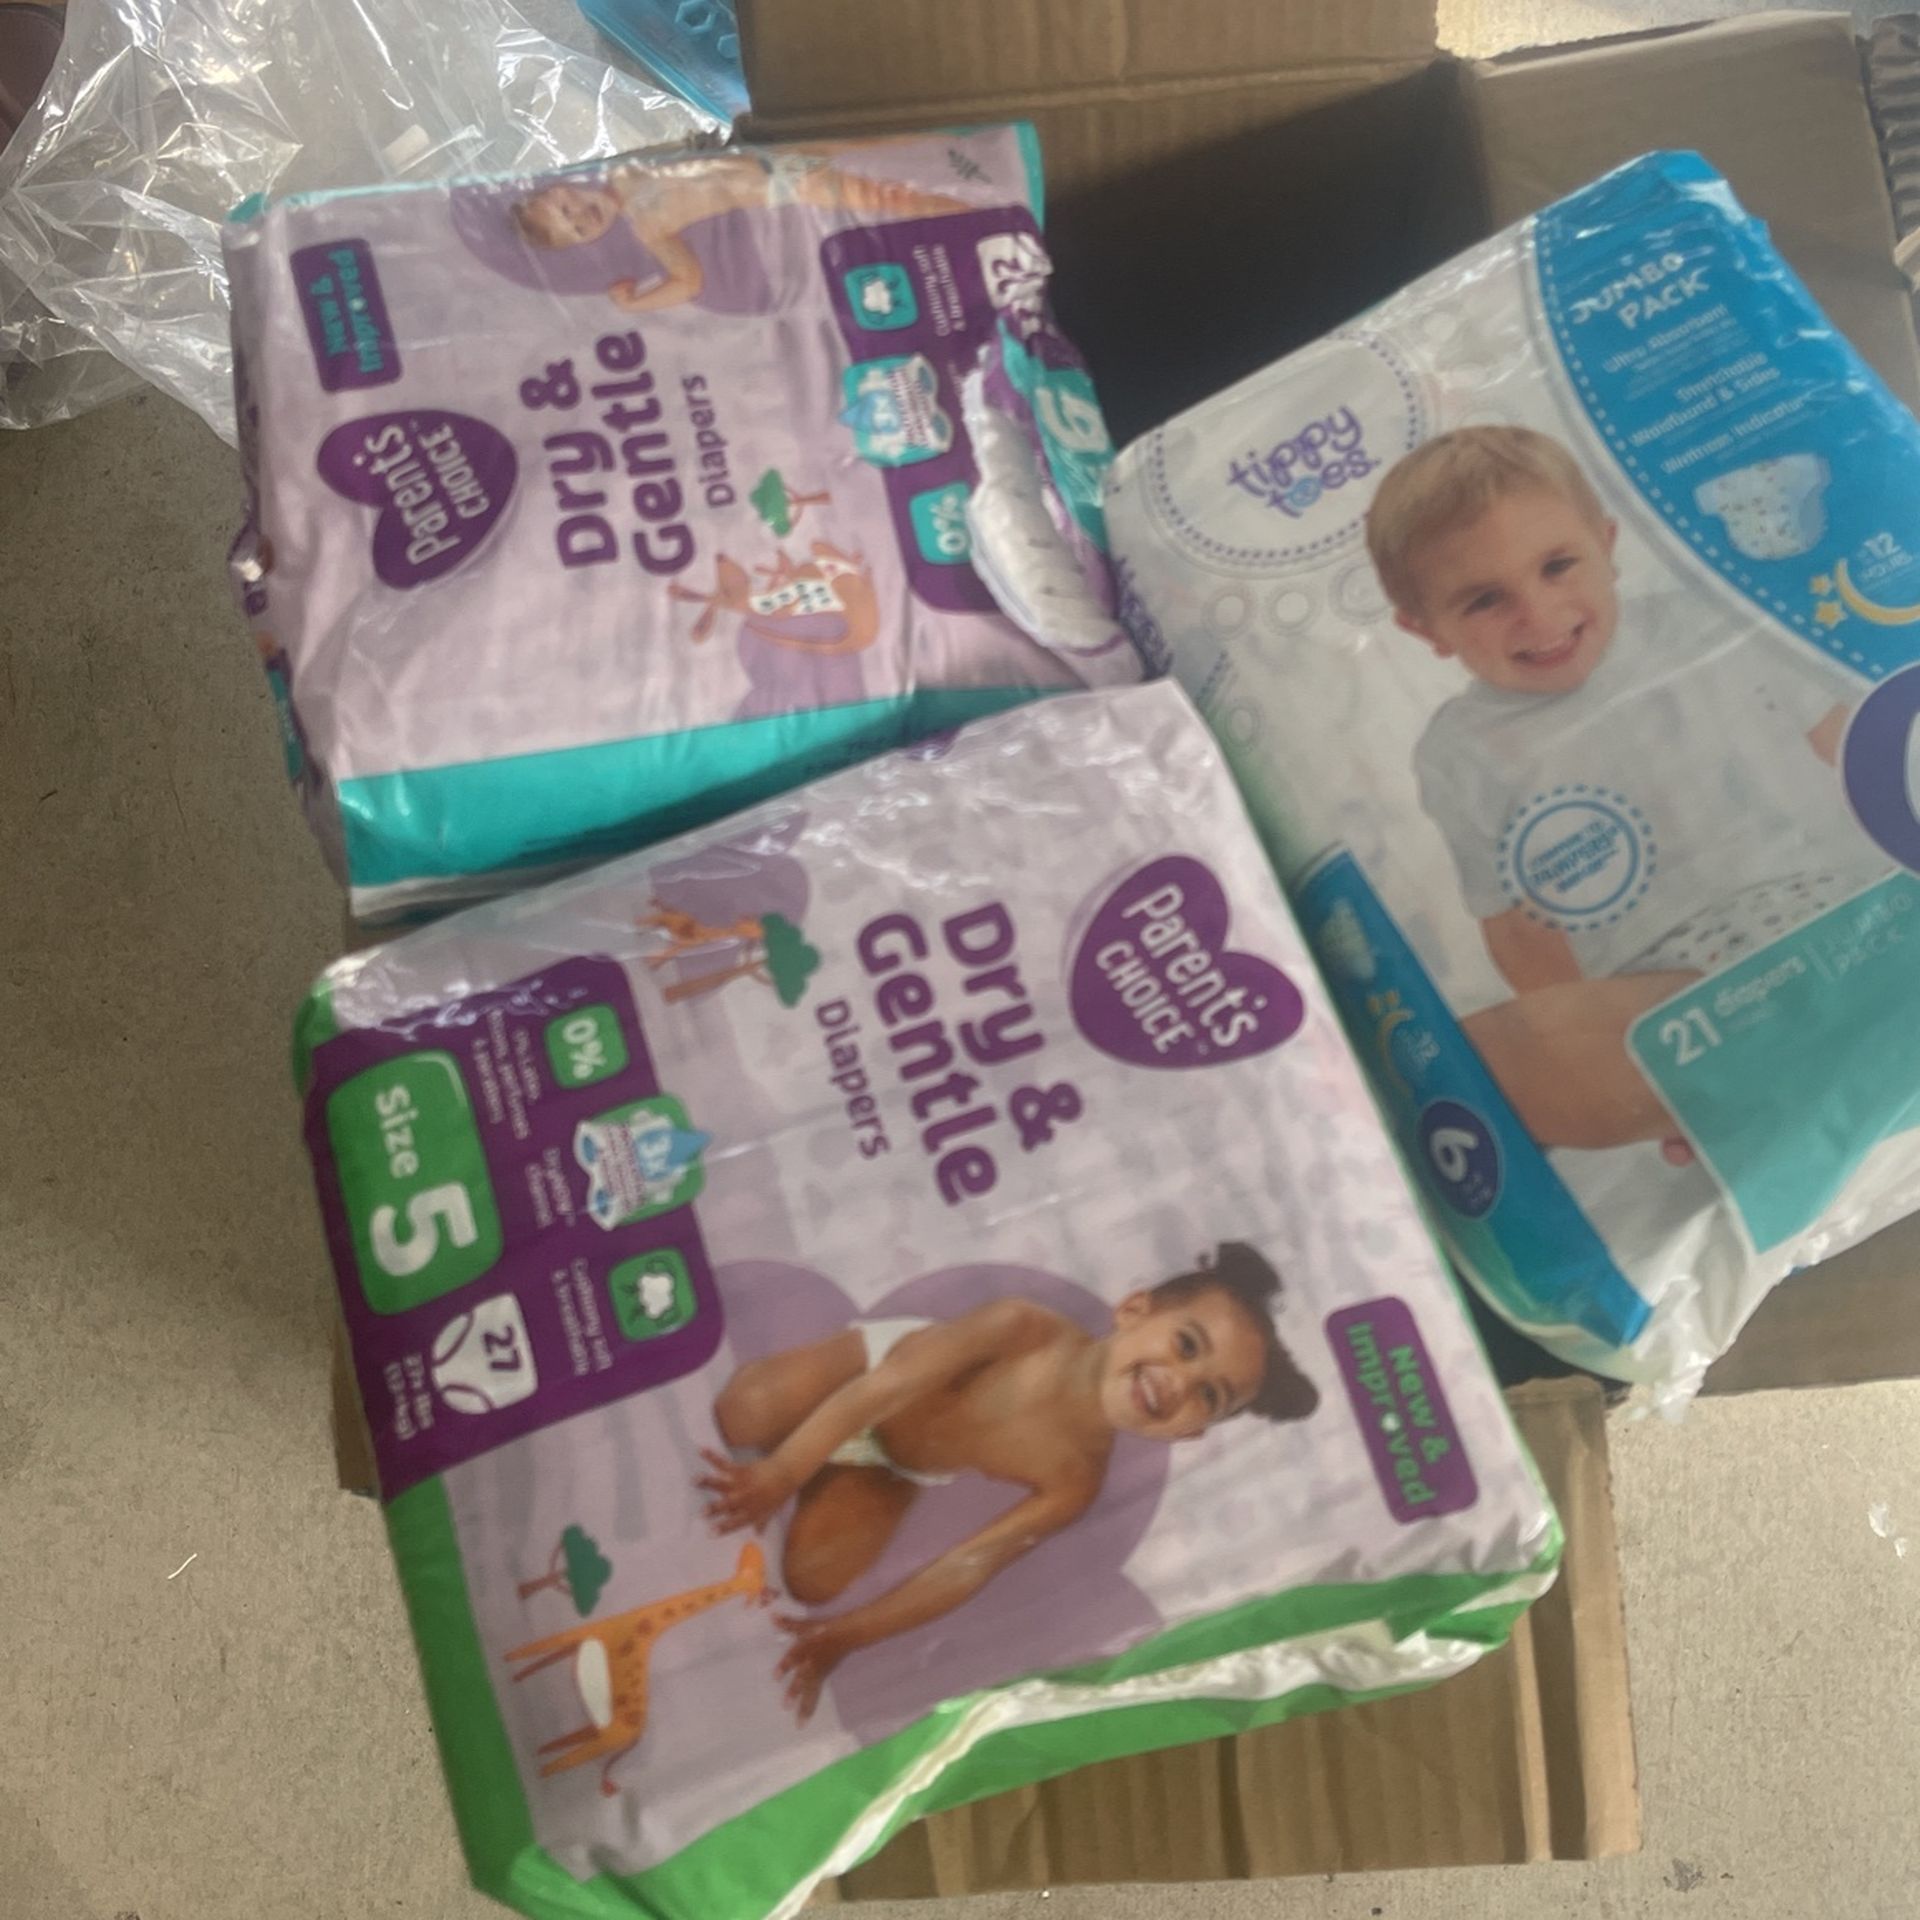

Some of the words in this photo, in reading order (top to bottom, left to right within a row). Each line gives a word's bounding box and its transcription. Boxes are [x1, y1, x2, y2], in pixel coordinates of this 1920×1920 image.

[1568, 252, 1684, 325] JUMBO
[1617, 266, 1711, 330] PACK
[519, 358, 581, 410] &
[420, 423, 490, 519] CHOICE
[591, 331, 696, 576] Gentle
[682, 374, 736, 509] Diapers
[1227, 406, 1362, 496] tippy
[1266, 449, 1381, 519] toes
[352, 424, 462, 566] Parent's
[543, 430, 619, 568] Dry
[930, 492, 968, 556] 0%
[1095, 939, 1194, 1054] CHOICE
[1121, 882, 1268, 1048] Parent's
[562, 1017, 607, 1080] 0%
[856, 913, 999, 1207] Gentle
[941, 901, 1045, 1066] Dry
[1008, 1082, 1083, 1153] &
[1659, 1007, 1723, 1067] 21
[815, 999, 890, 1160] Diapers
[375, 1083, 418, 1178] Size
[1430, 1127, 1480, 1183] 6
[369, 1182, 478, 1277] 5
[483, 1325, 523, 1372] 27
[1389, 1345, 1436, 1428] New
[1420, 1437, 1449, 1465] &
